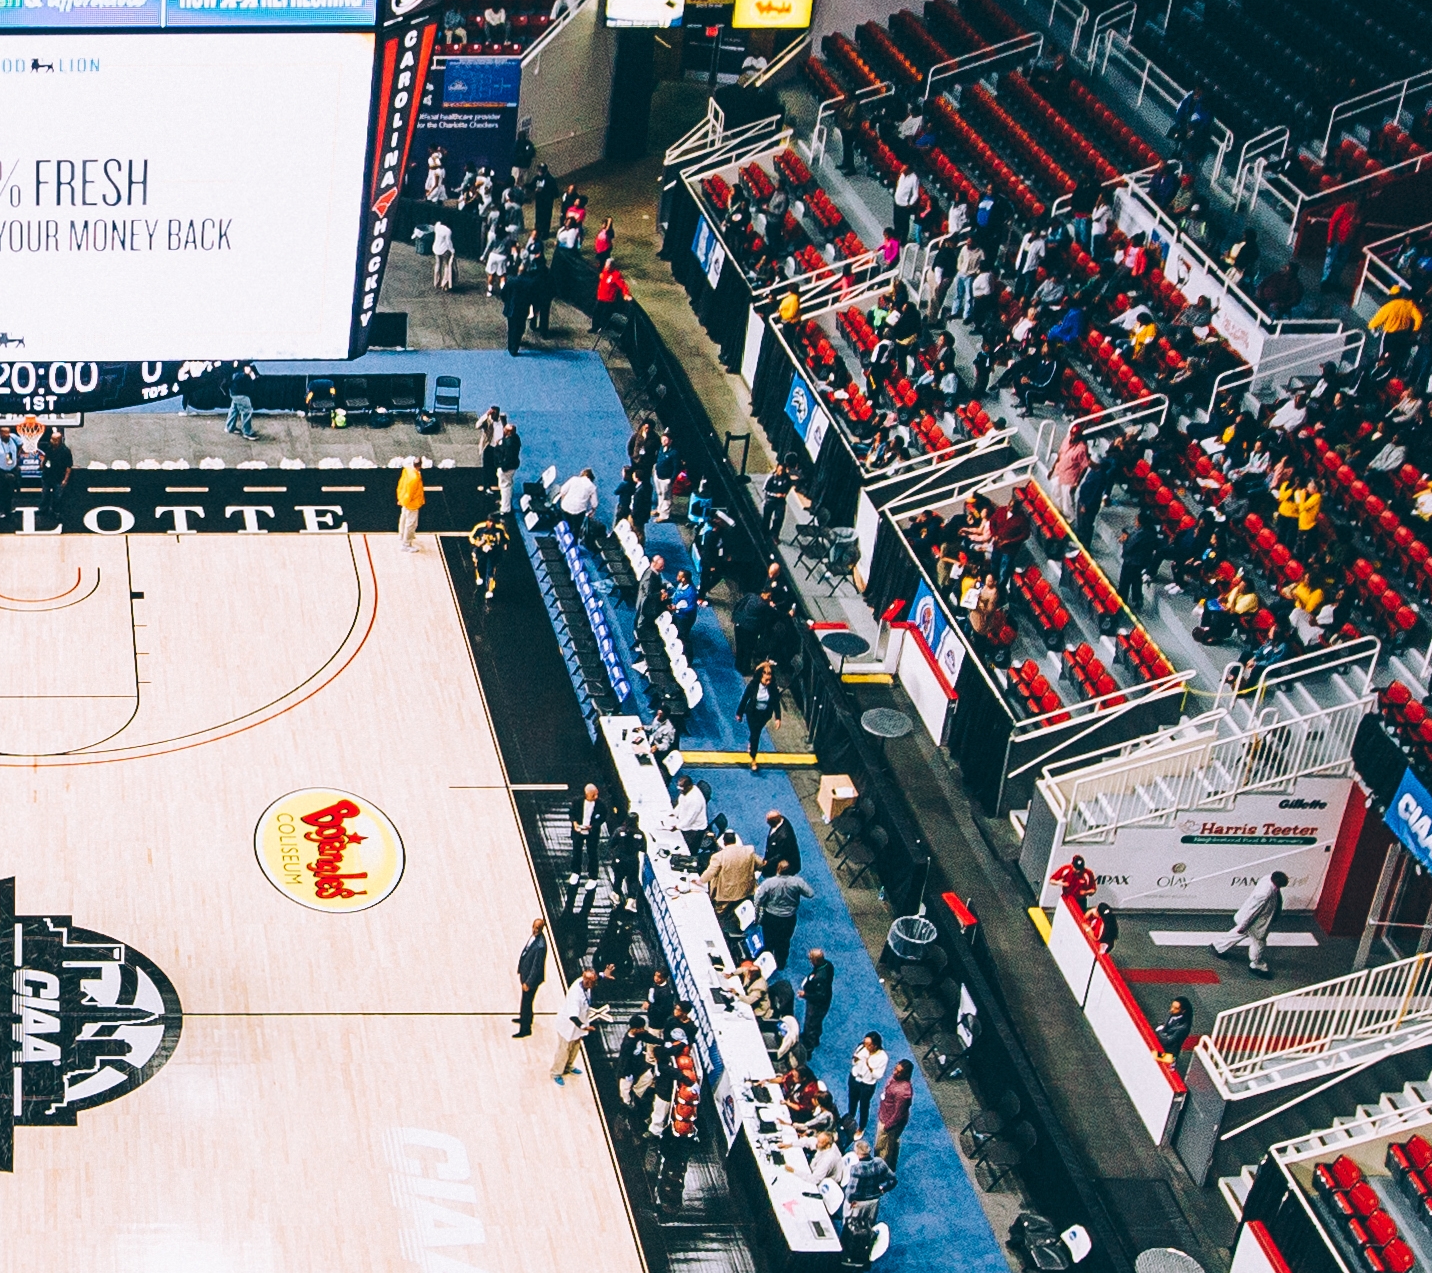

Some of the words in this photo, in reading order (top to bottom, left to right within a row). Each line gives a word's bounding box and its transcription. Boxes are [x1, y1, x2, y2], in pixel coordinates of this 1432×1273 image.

[59, 58, 101, 73] LION
[380, 29, 418, 189] CAROLINA
[35, 159, 148, 207] FRESH
[69, 218, 159, 252] MONEY
[167, 218, 233, 251] BACK
[358, 217, 389, 329] HOCKEY
[22, 395, 59, 412] 1ST
[1278, 798, 1328, 811] Gillette
[1200, 821, 1258, 836] Harris
[1263, 820, 1319, 836] Teeter
[275, 812, 304, 886] COLISEUM
[1092, 874, 1132, 887] MPAX
[12, 966, 63, 1067] CIAA
